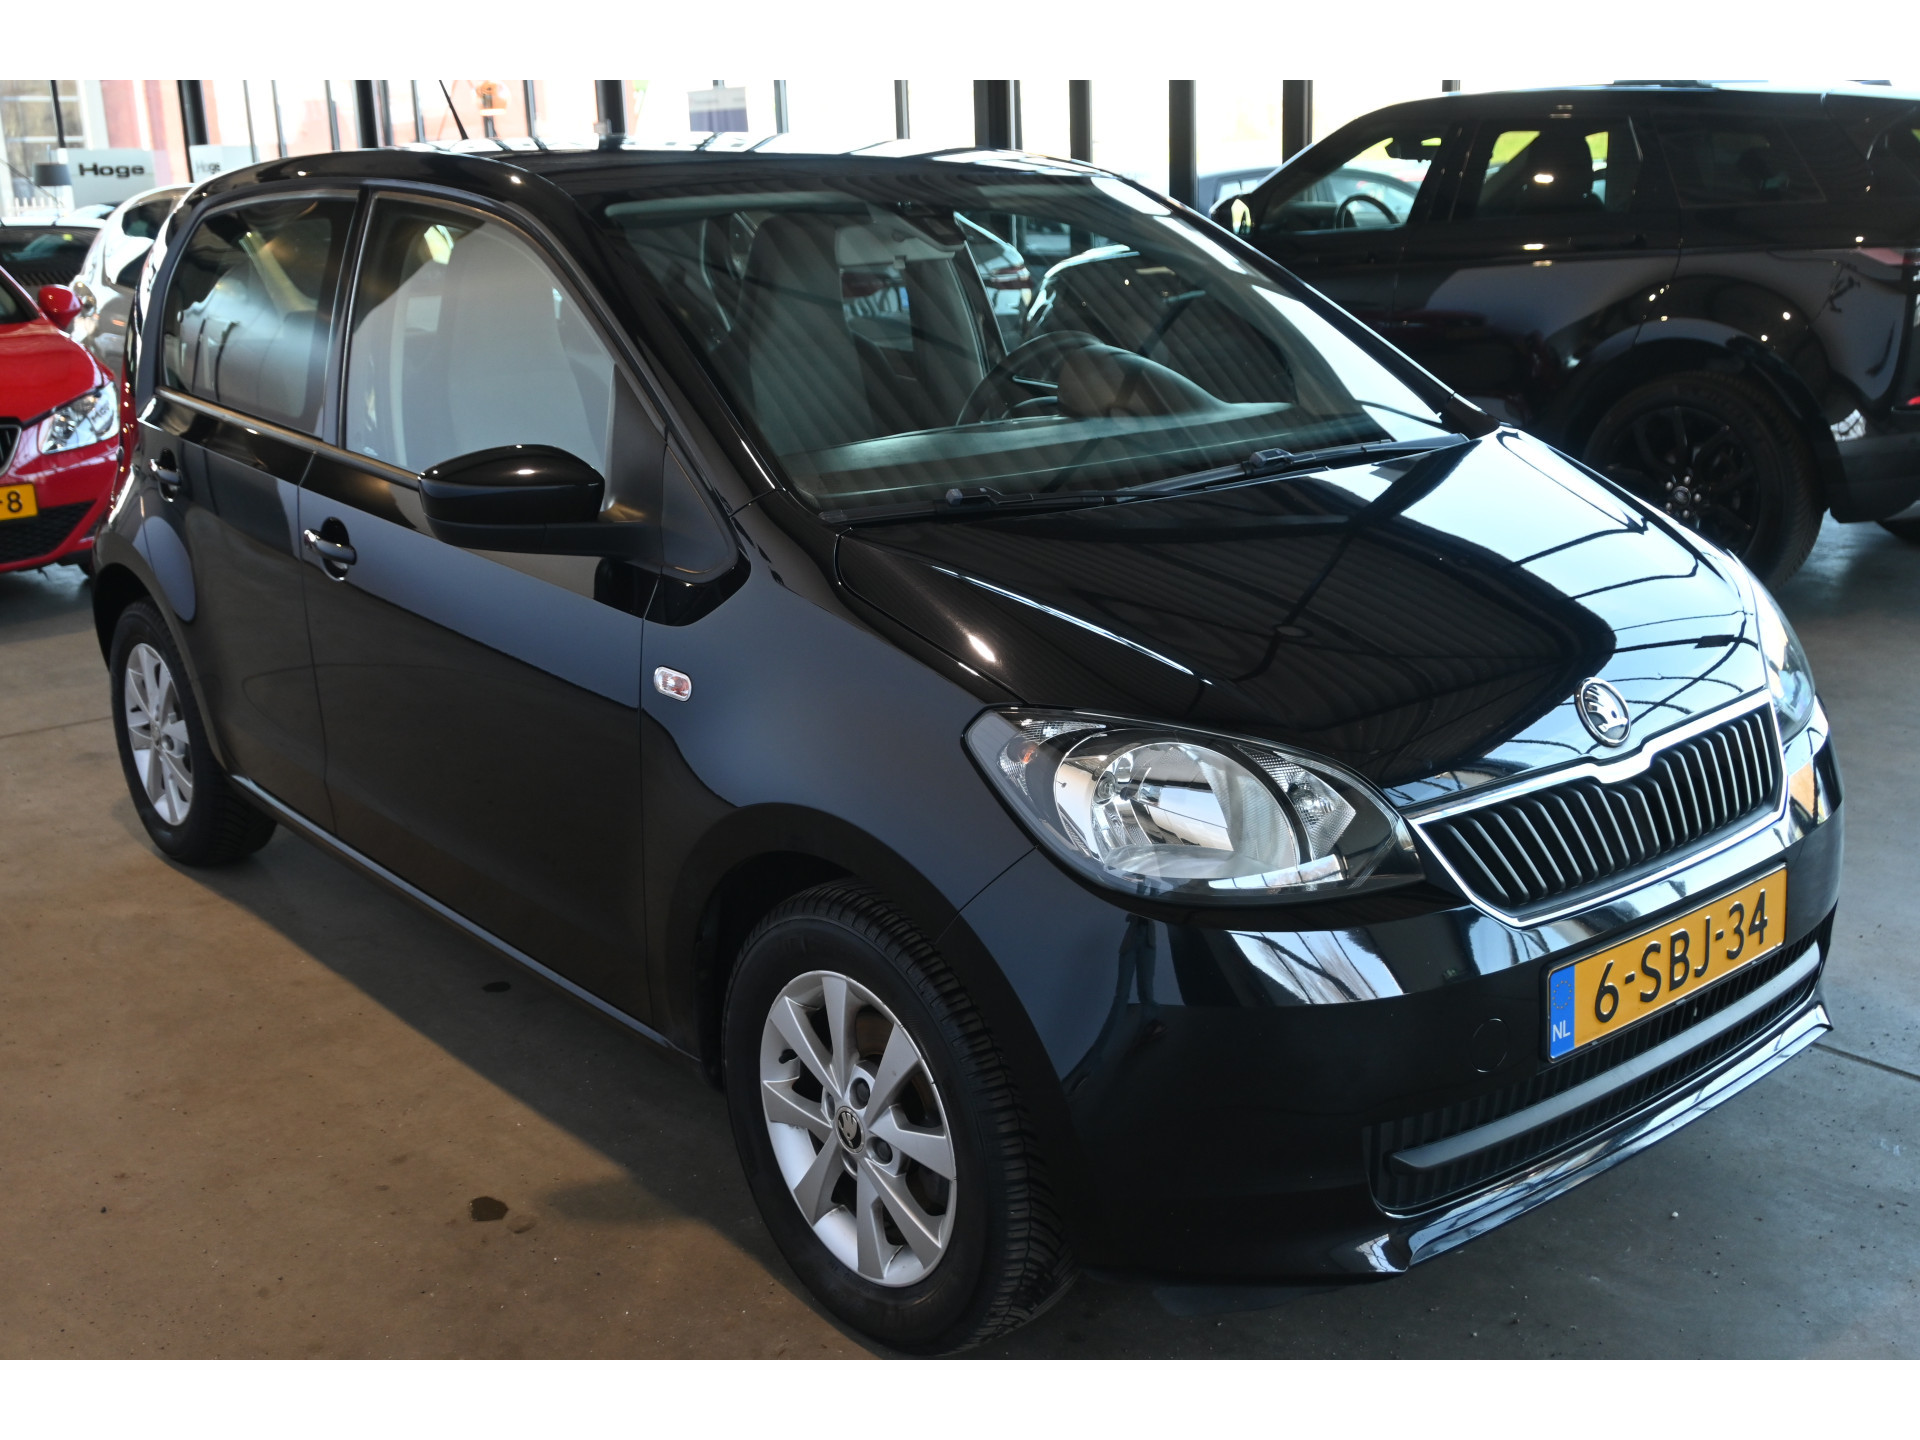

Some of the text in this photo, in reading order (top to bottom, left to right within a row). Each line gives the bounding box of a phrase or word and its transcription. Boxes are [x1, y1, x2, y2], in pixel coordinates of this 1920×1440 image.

[79, 163, 145, 178] Hoge
[1595, 889, 1768, 1023] 6-SBJ-34
[1552, 1020, 1571, 1042] NL
